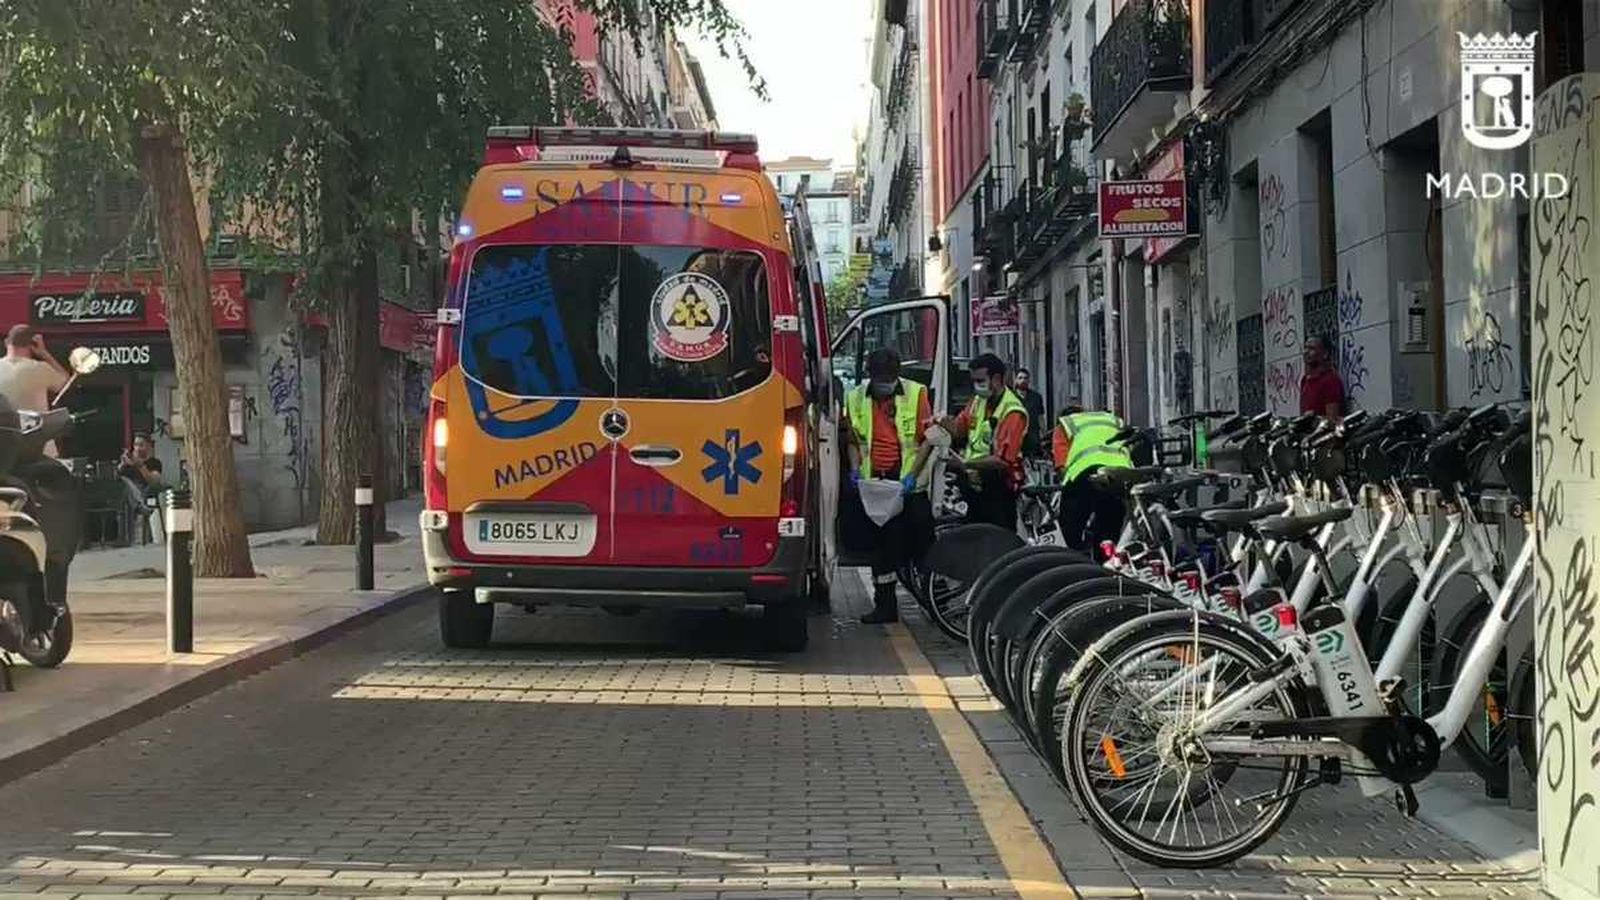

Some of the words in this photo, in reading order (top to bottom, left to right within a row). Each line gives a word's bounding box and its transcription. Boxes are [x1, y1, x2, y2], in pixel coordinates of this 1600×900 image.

[1108, 183, 1164, 196] FRUTOS
[1132, 197, 1182, 208] SECOS
[494, 441, 597, 490] MADRID
[491, 522, 537, 540] 8065
[543, 523, 578, 541] LKJ
[1337, 671, 1364, 711] 6341
